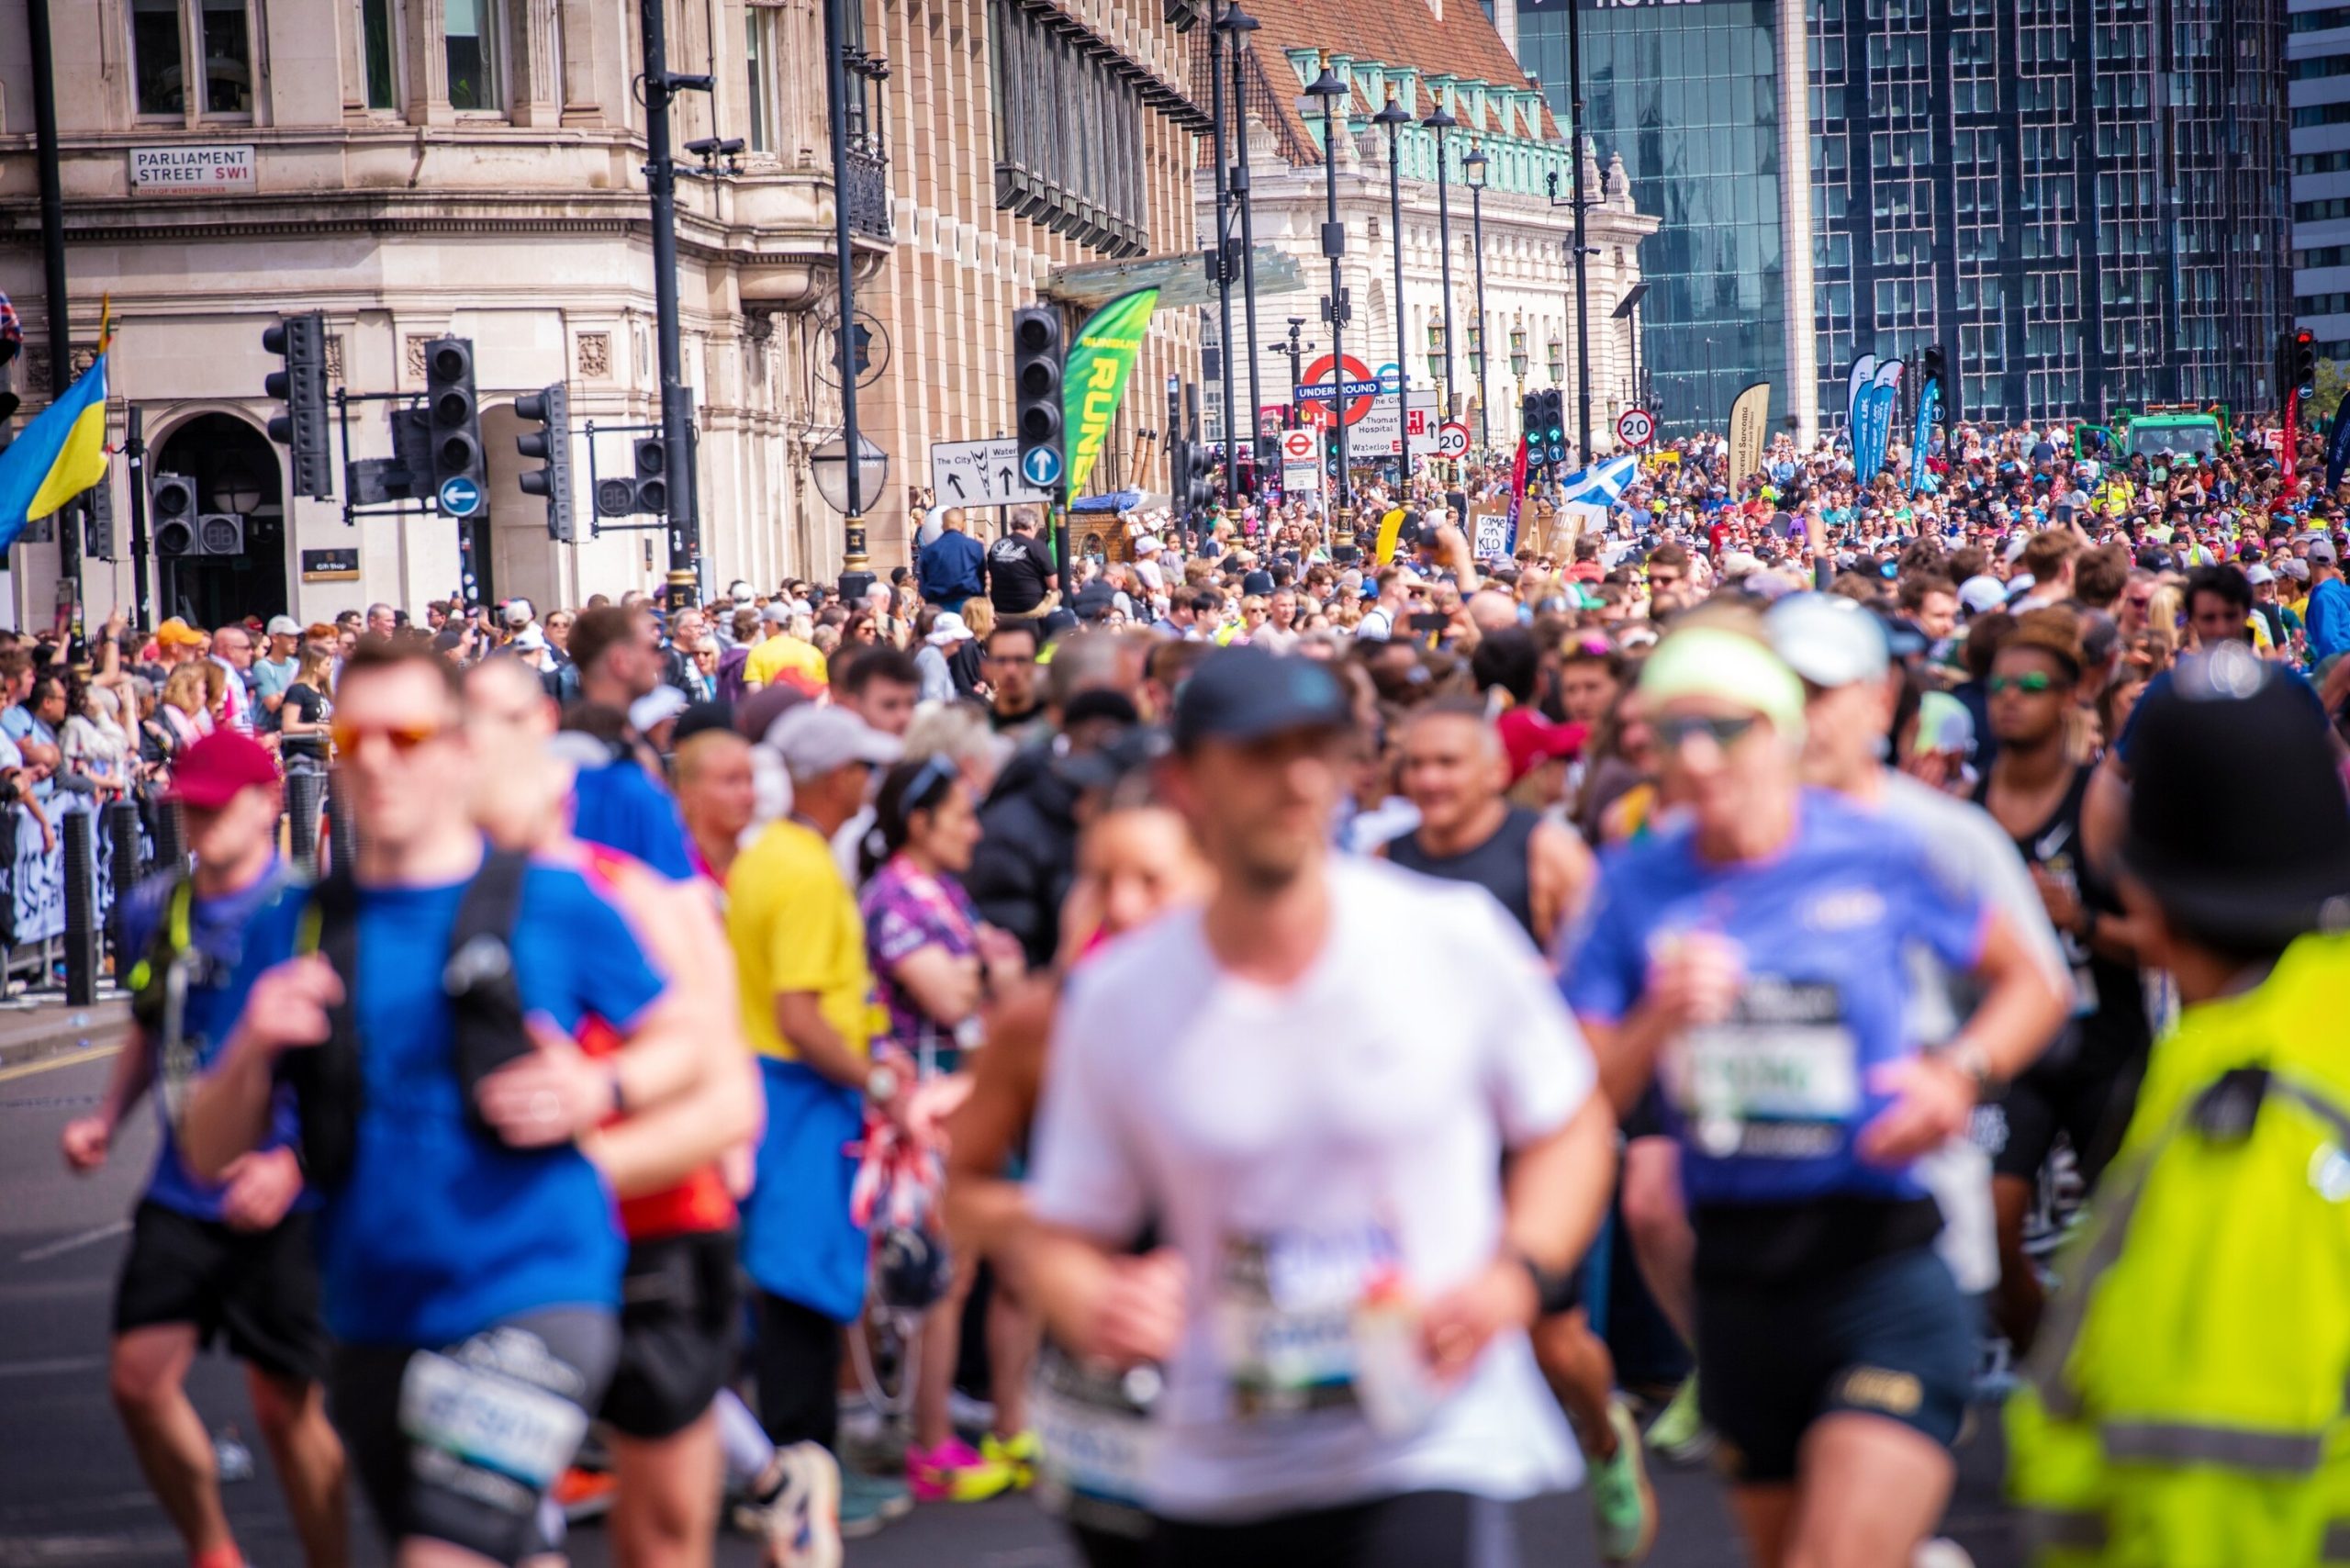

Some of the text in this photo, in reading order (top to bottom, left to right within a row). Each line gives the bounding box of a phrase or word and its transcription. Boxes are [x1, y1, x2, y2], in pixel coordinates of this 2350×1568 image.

[138, 151, 245, 166] PARLIAMENT
[140, 166, 248, 182] STREET SW1
[1388, 397, 1400, 405] Cit
[1359, 426, 1393, 434] Hospital
[1622, 420, 1649, 436] 20
[1739, 407, 1748, 448] Sarcoma
[1351, 443, 1390, 452] Waterloo
[1440, 433, 1464, 449] 20
[992, 447, 1017, 456] Water
[937, 455, 972, 465] The City
[1478, 536, 1501, 550] KID
